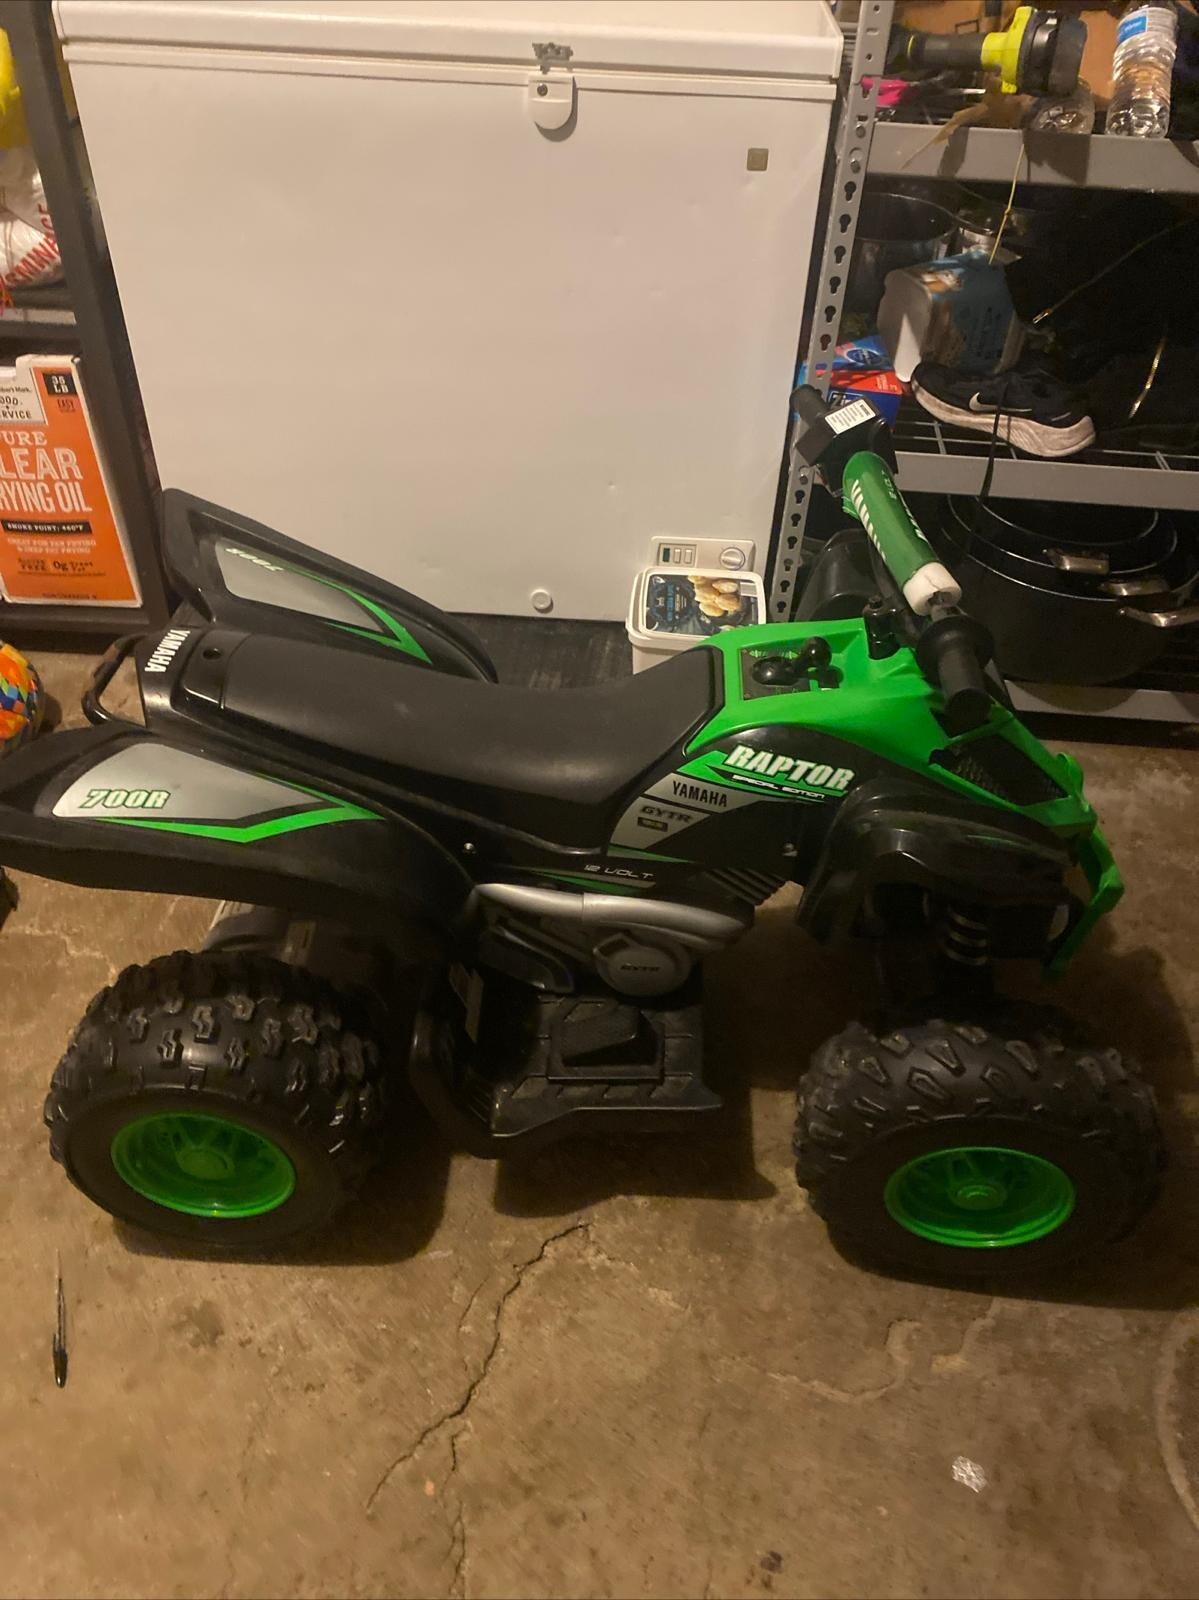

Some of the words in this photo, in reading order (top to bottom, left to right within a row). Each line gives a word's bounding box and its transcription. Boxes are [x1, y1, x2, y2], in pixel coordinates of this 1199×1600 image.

[54, 481, 93, 513] OIL
[144, 629, 191, 672] YAMAHA
[723, 744, 856, 790] RAPTOR
[78, 788, 171, 809] 700R
[673, 780, 728, 807] YAMAHA
[641, 805, 692, 823] GYTR
[604, 867, 654, 879] VOLT
